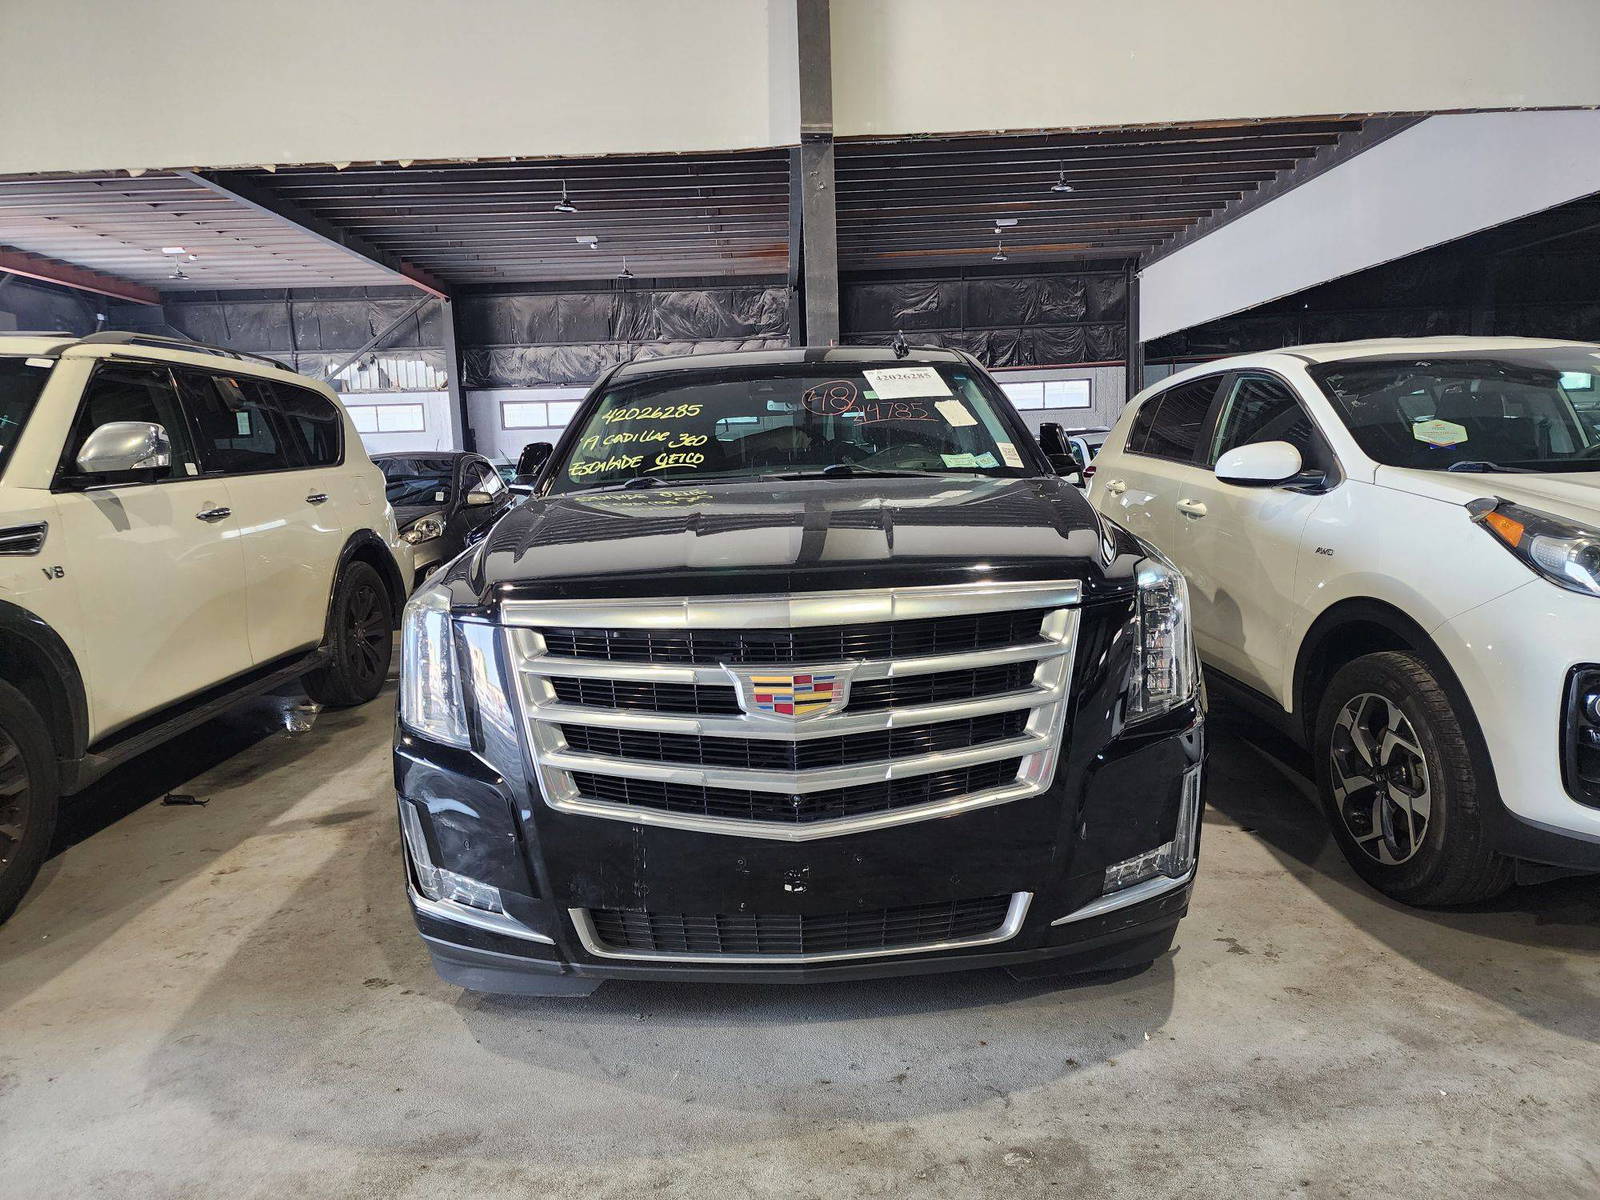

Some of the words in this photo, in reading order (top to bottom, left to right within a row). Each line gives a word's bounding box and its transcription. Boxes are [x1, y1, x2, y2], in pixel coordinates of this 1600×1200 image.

[602, 404, 703, 424] 42026285
[668, 433, 708, 448] 360
[568, 454, 644, 476] ESCALADE
[655, 452, 705, 467] GEICO
[1314, 546, 1334, 556] AWD
[41, 565, 65, 581] V8
